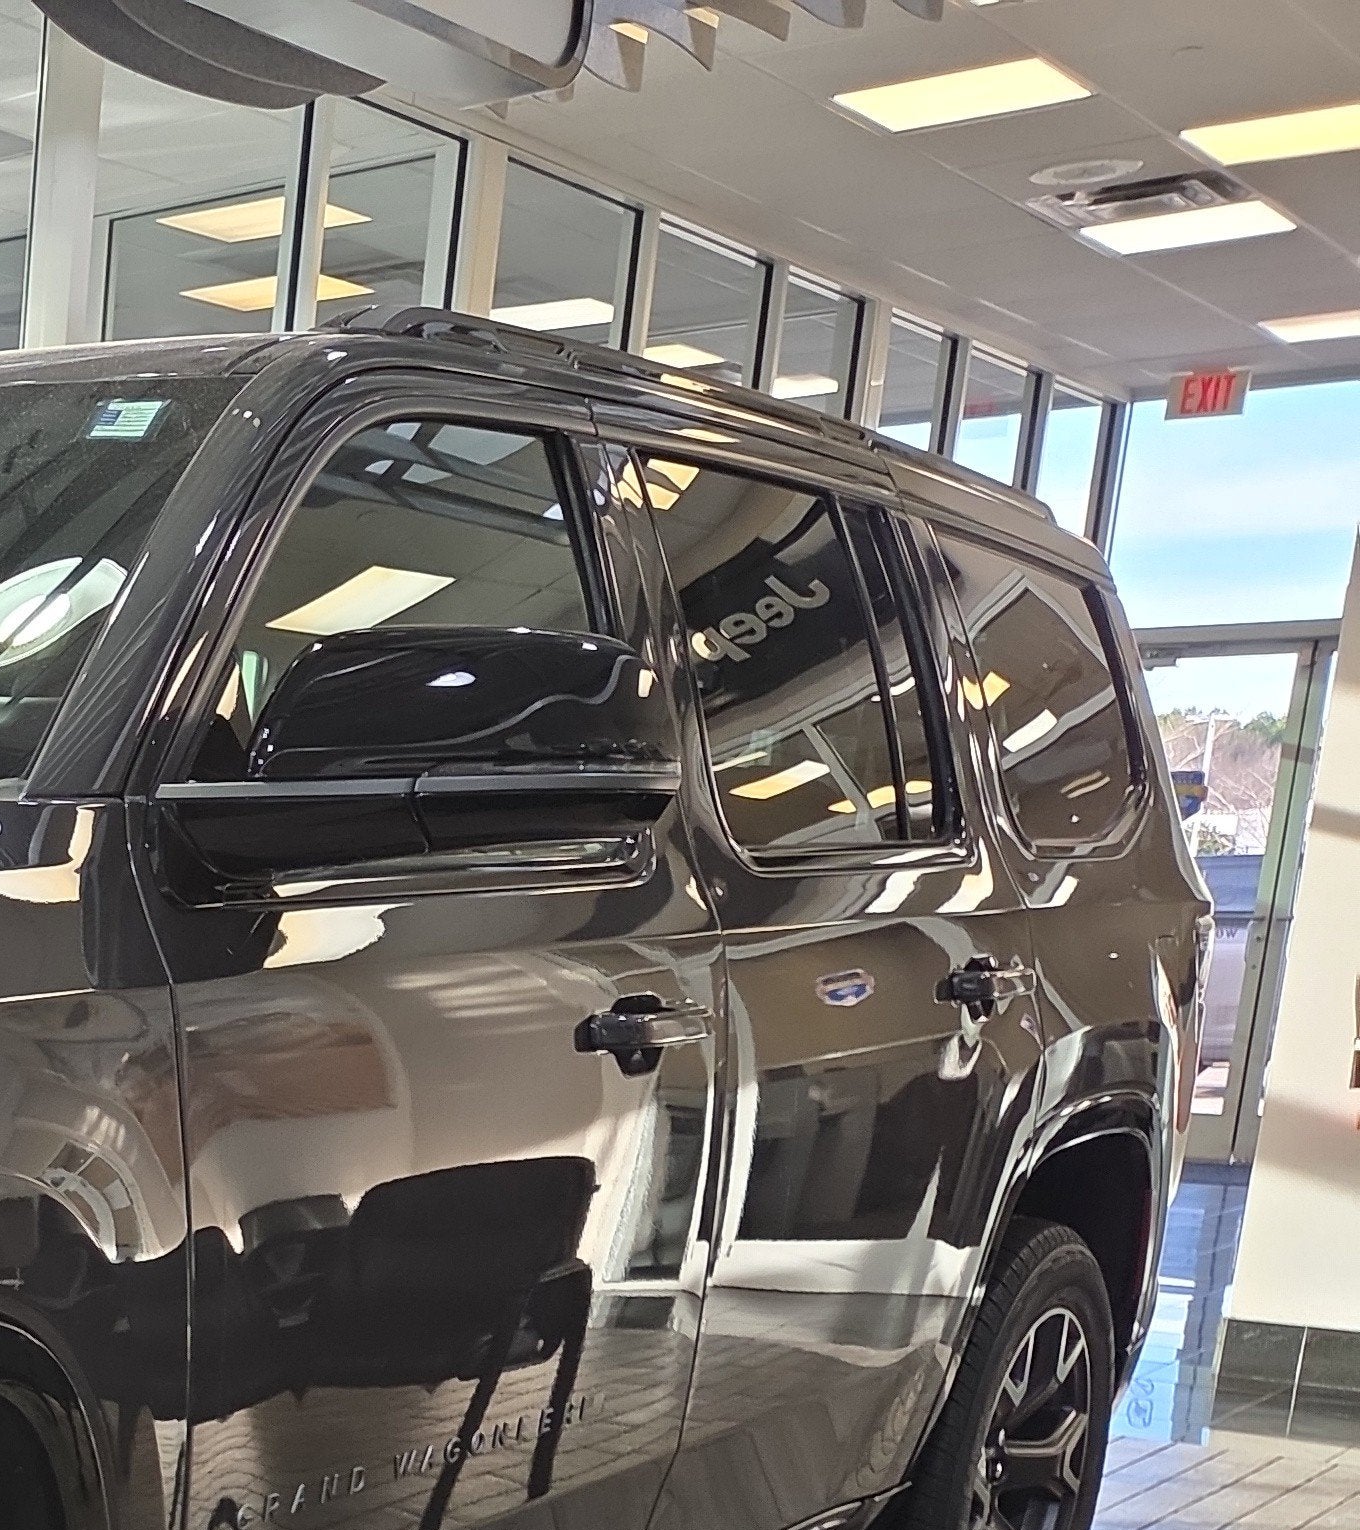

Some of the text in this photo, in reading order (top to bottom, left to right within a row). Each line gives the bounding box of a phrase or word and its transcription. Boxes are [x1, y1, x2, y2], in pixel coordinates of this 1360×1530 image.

[1180, 373, 1236, 414] EXIT
[236, 1392, 606, 1530] GRAND WAGONEER
